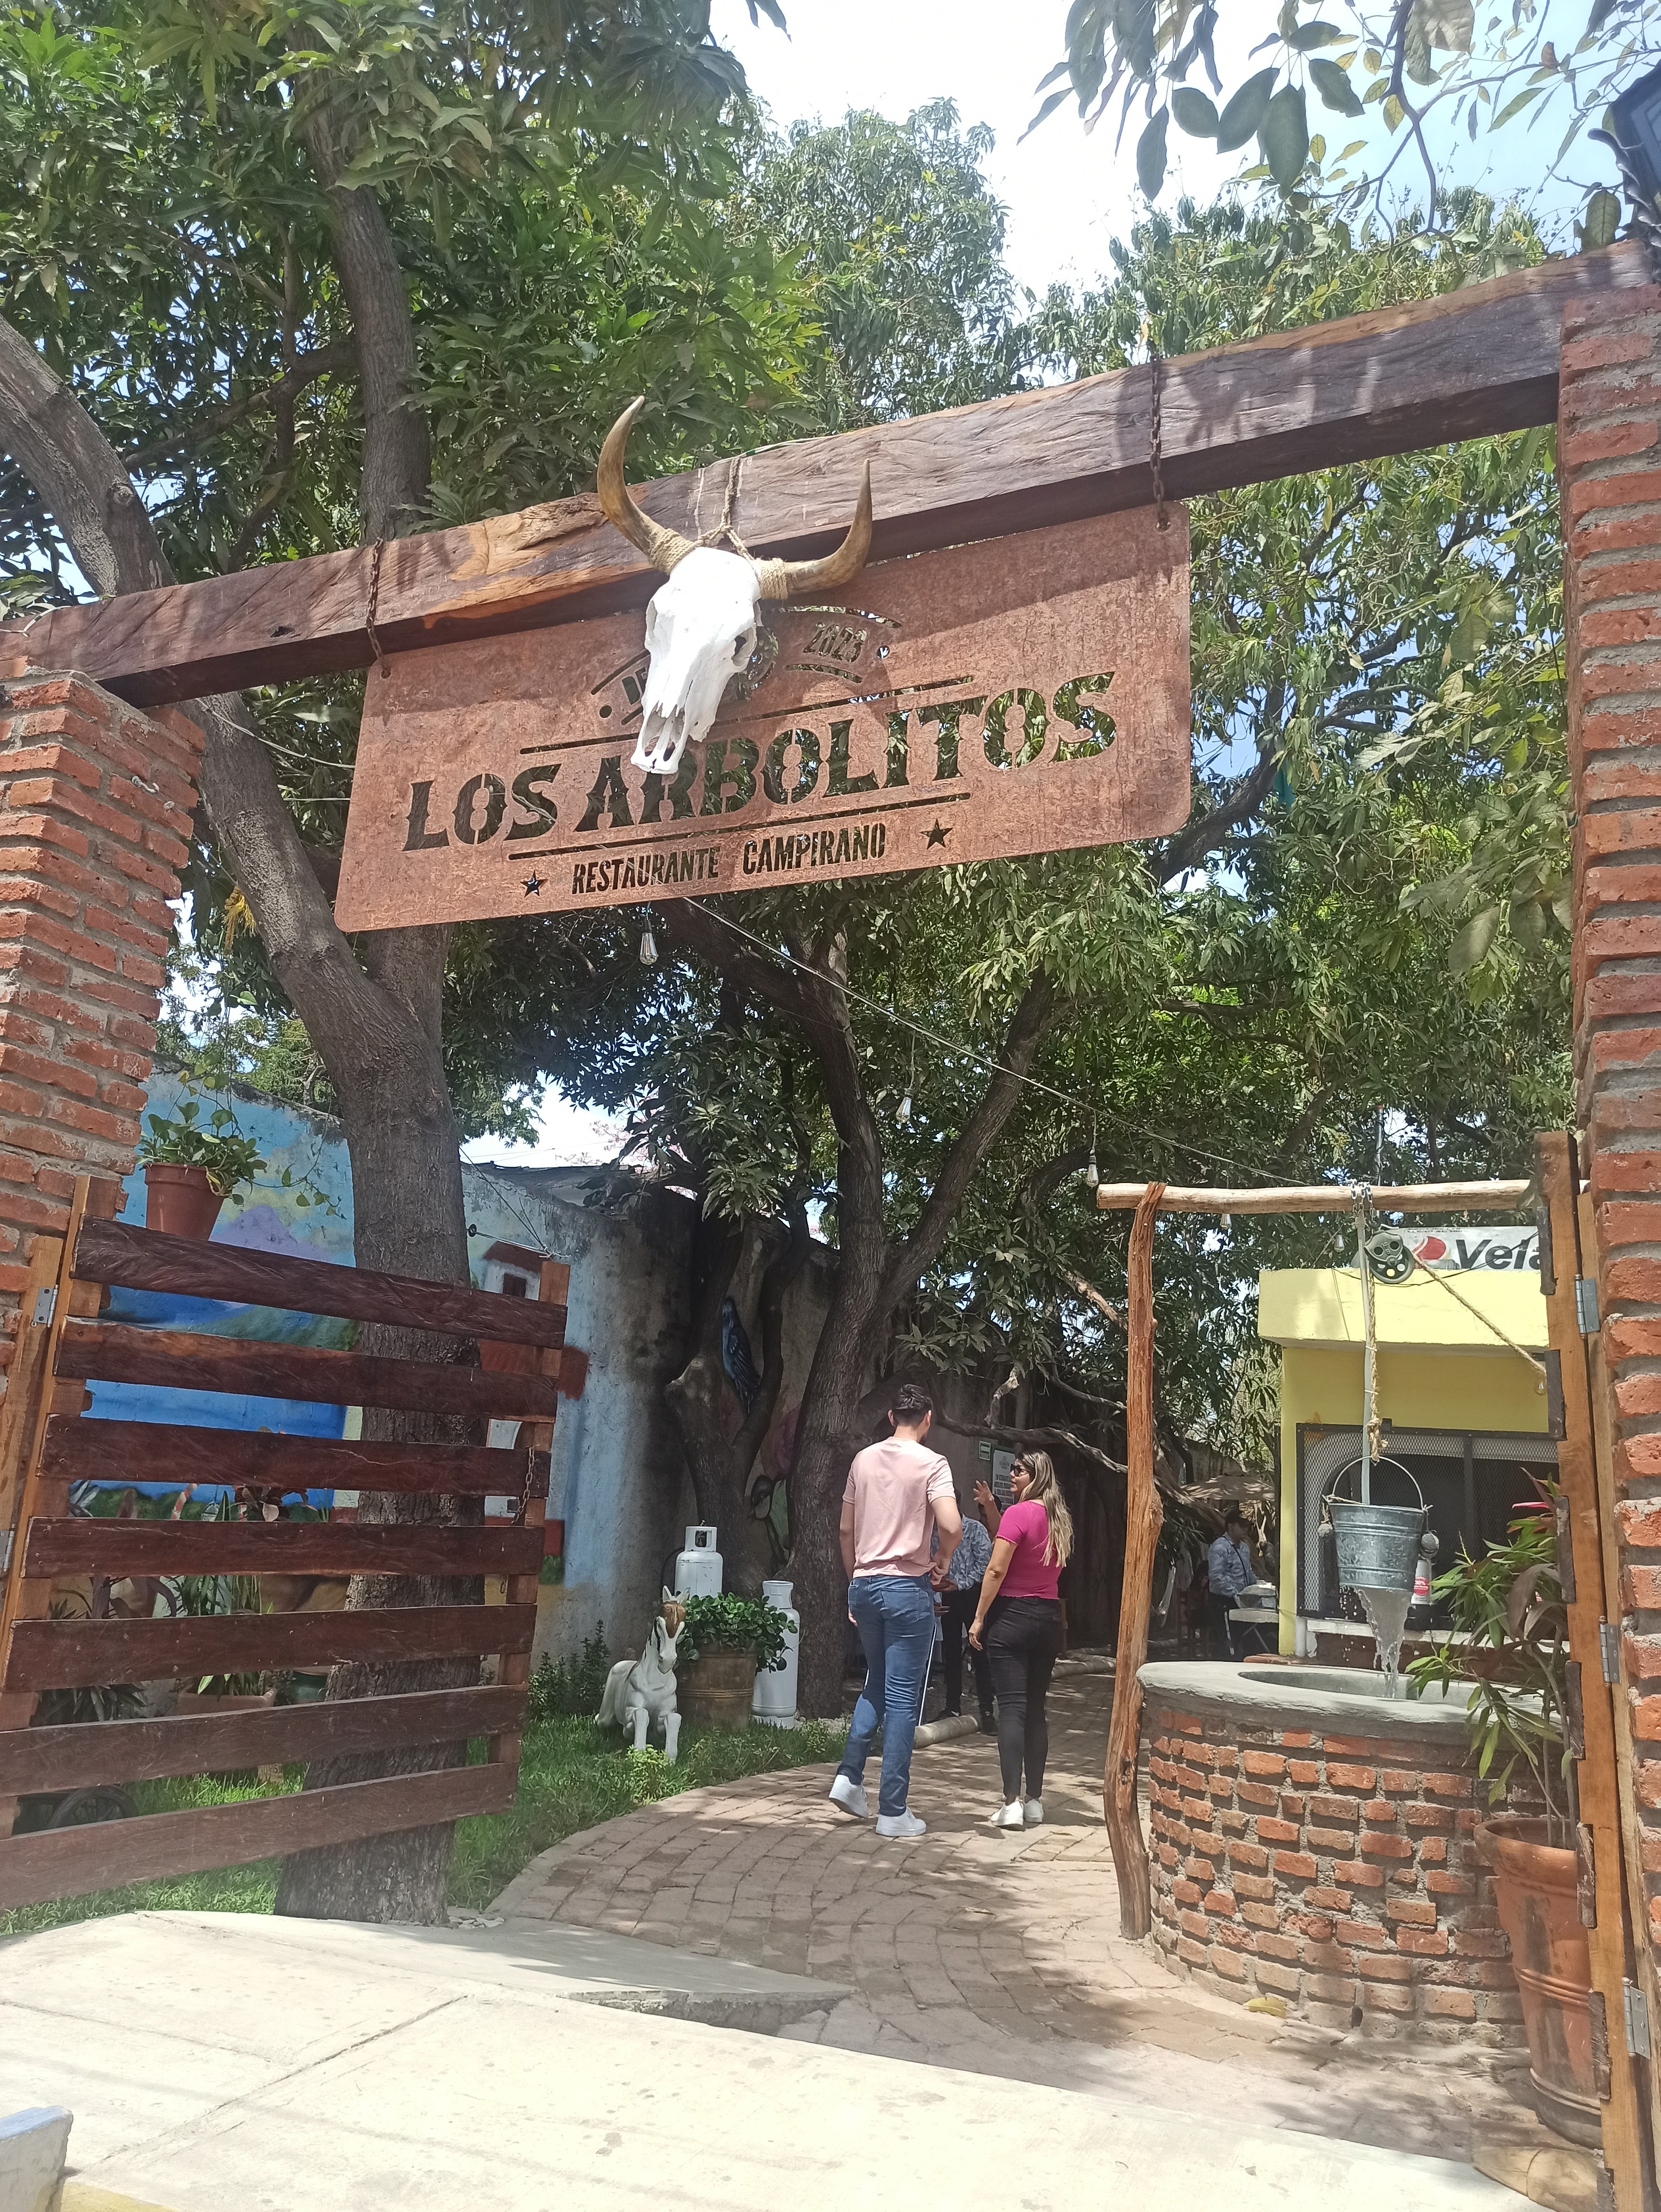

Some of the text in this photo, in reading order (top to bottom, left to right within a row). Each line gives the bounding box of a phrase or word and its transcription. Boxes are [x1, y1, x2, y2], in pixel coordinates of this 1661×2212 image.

[802, 621, 867, 663] 2023
[402, 671, 1117, 852] LOS ARBOLITOS
[572, 822, 886, 895] RESTAURANTE CAMPIRANO
